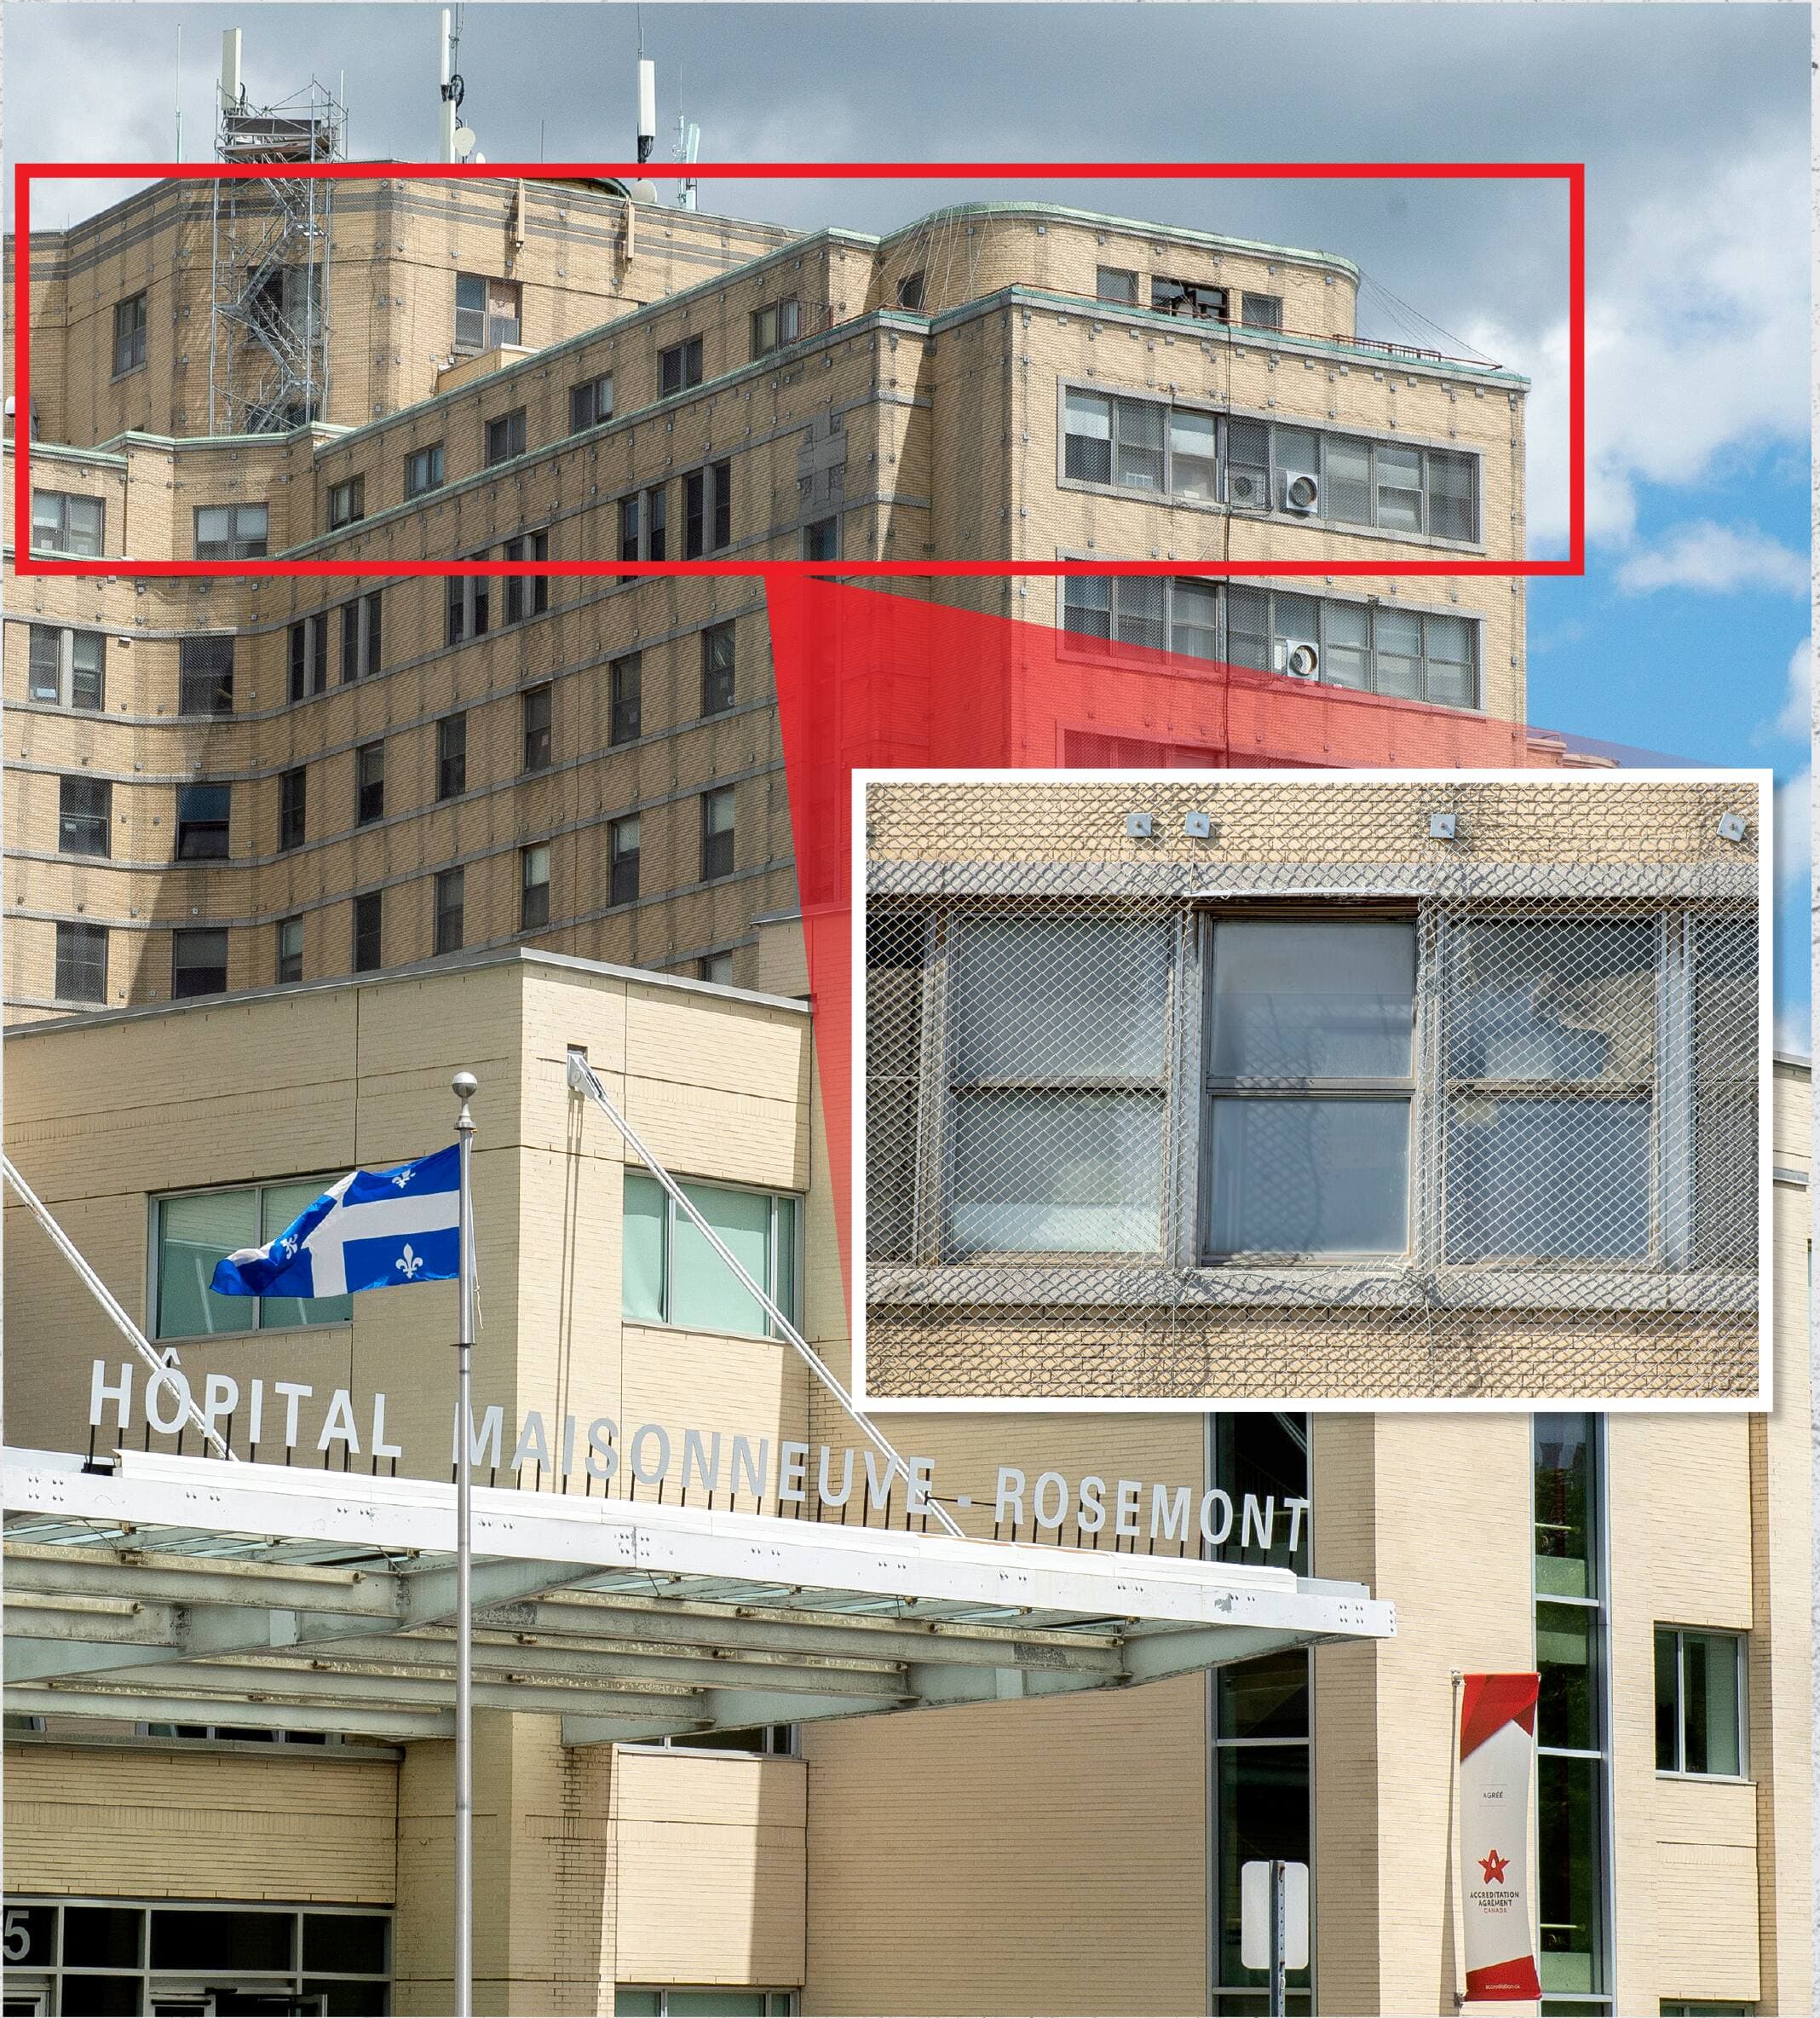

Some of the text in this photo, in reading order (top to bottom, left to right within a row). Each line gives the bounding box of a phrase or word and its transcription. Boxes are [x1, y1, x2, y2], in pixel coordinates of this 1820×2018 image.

[89, 1347, 402, 1458] HÔPITAL
[452, 1401, 936, 1515] MAISONNEUVE
[994, 1466, 1311, 1553] ROSEMONT
[1483, 1790, 1504, 1799] AGRÉÉ
[3, 1910, 31, 1961] 5
